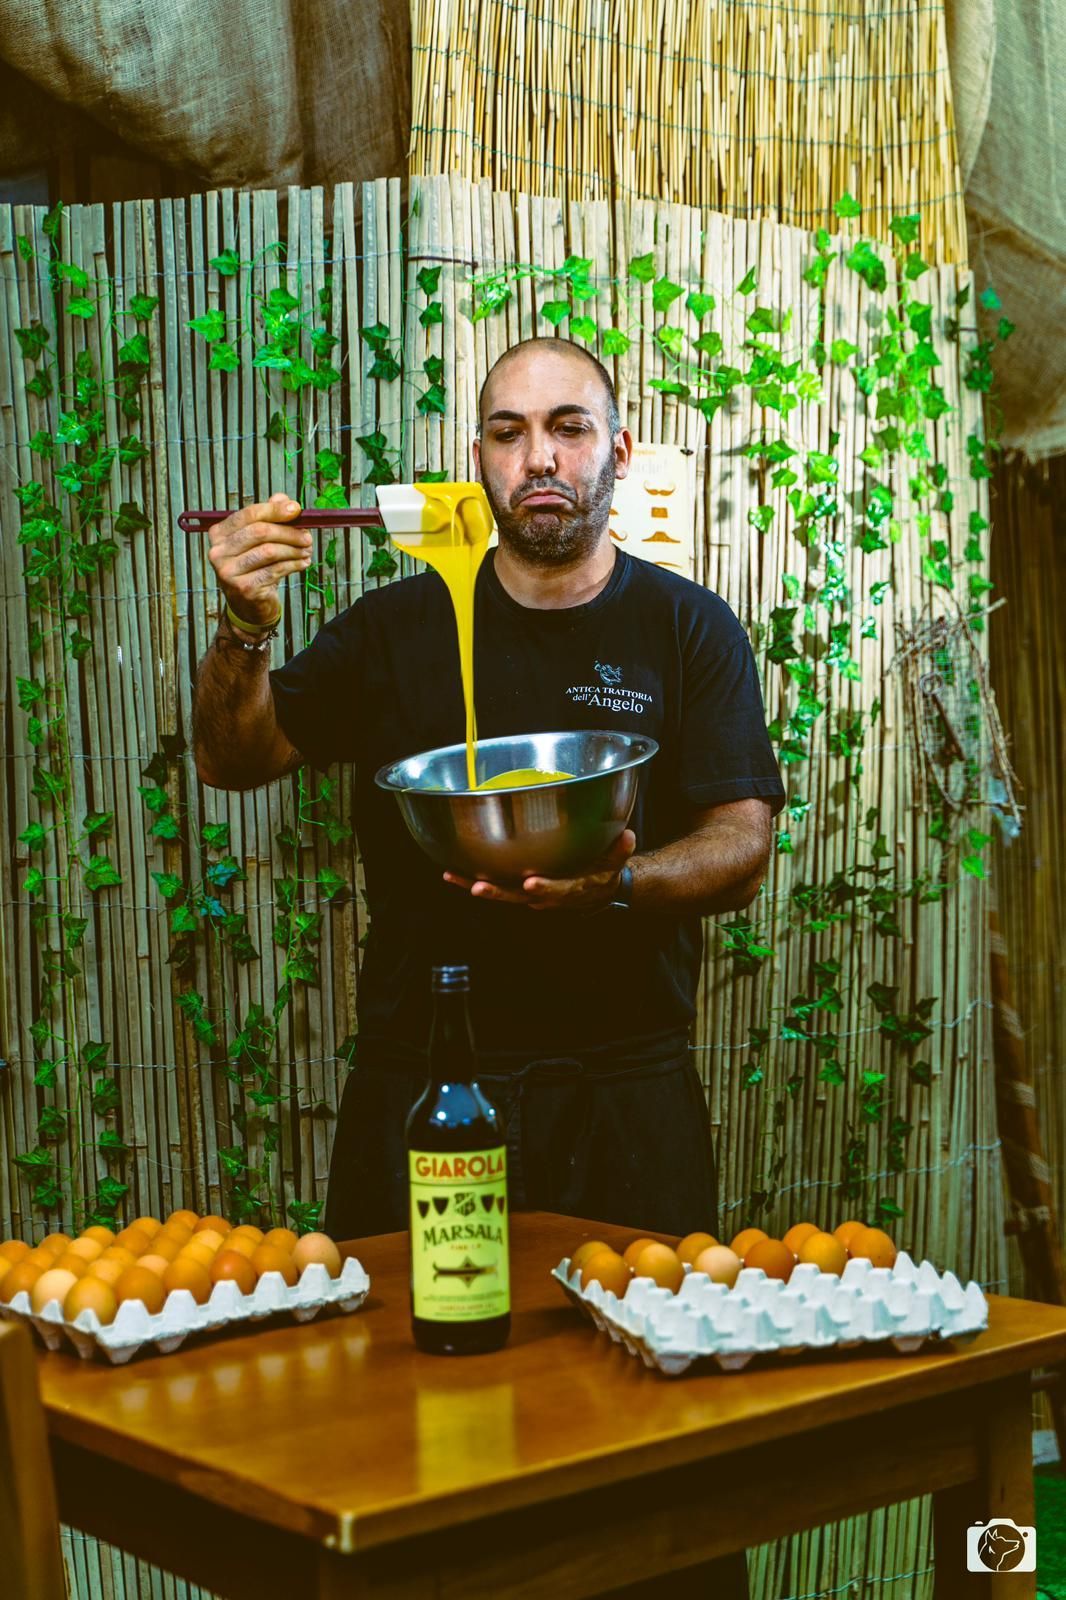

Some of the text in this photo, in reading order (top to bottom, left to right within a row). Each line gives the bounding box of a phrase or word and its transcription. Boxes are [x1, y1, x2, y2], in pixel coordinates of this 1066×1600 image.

[565, 686, 653, 702] ANTICA TRATTORIA
[416, 1155, 504, 1177] GIAROLA
[423, 1223, 503, 1251] MARSALA
